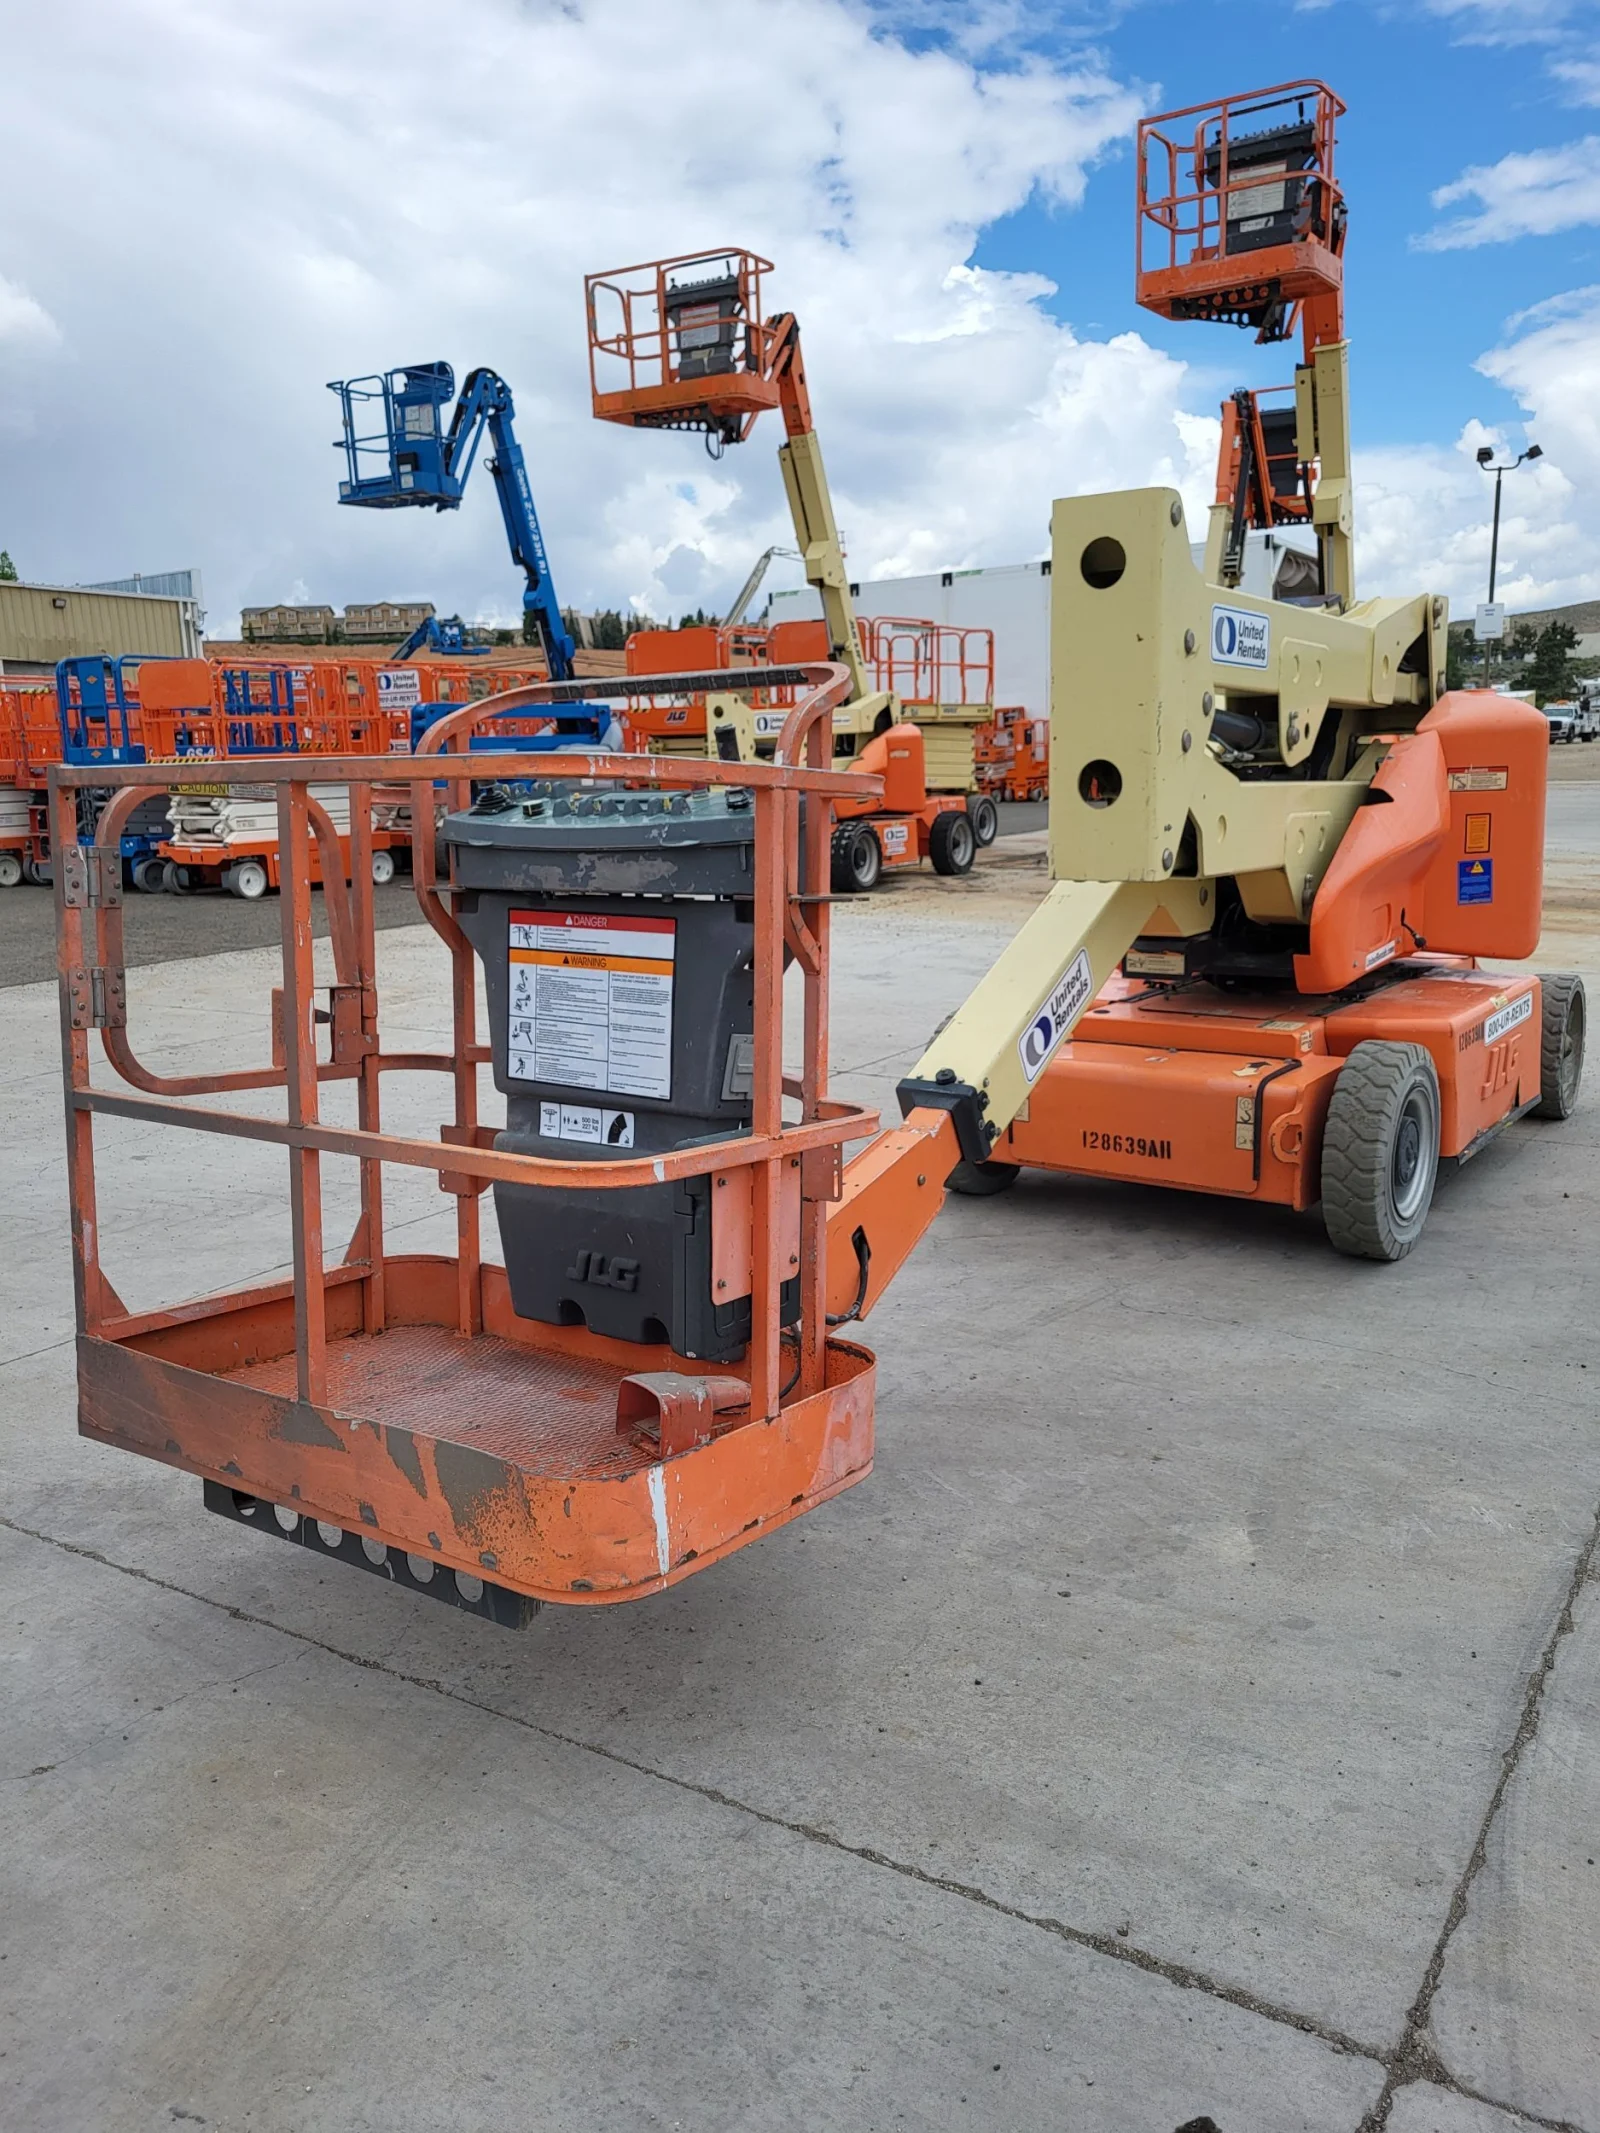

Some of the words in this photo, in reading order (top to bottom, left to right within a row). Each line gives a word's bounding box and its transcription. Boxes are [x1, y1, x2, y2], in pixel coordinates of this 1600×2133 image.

[1238, 620, 1265, 641] United
[1237, 640, 1266, 661] Rentals
[392, 673, 415, 682] United
[393, 682, 417, 690] Rentals
[666, 711, 686, 722] JLG
[180, 783, 226, 795] CAUTION
[573, 915, 608, 928] DANGER
[571, 957, 607, 968] WARNING
[1050, 960, 1083, 1017] United
[1054, 978, 1089, 1034] Rentals
[1487, 998, 1531, 1039] 800-UR-RENTS
[1480, 1034, 1522, 1102] JLG
[581, 1116, 591, 1124] 500
[591, 1117, 600, 1125] lbs
[592, 1124, 599, 1132] kg
[565, 1249, 641, 1292] JLG
